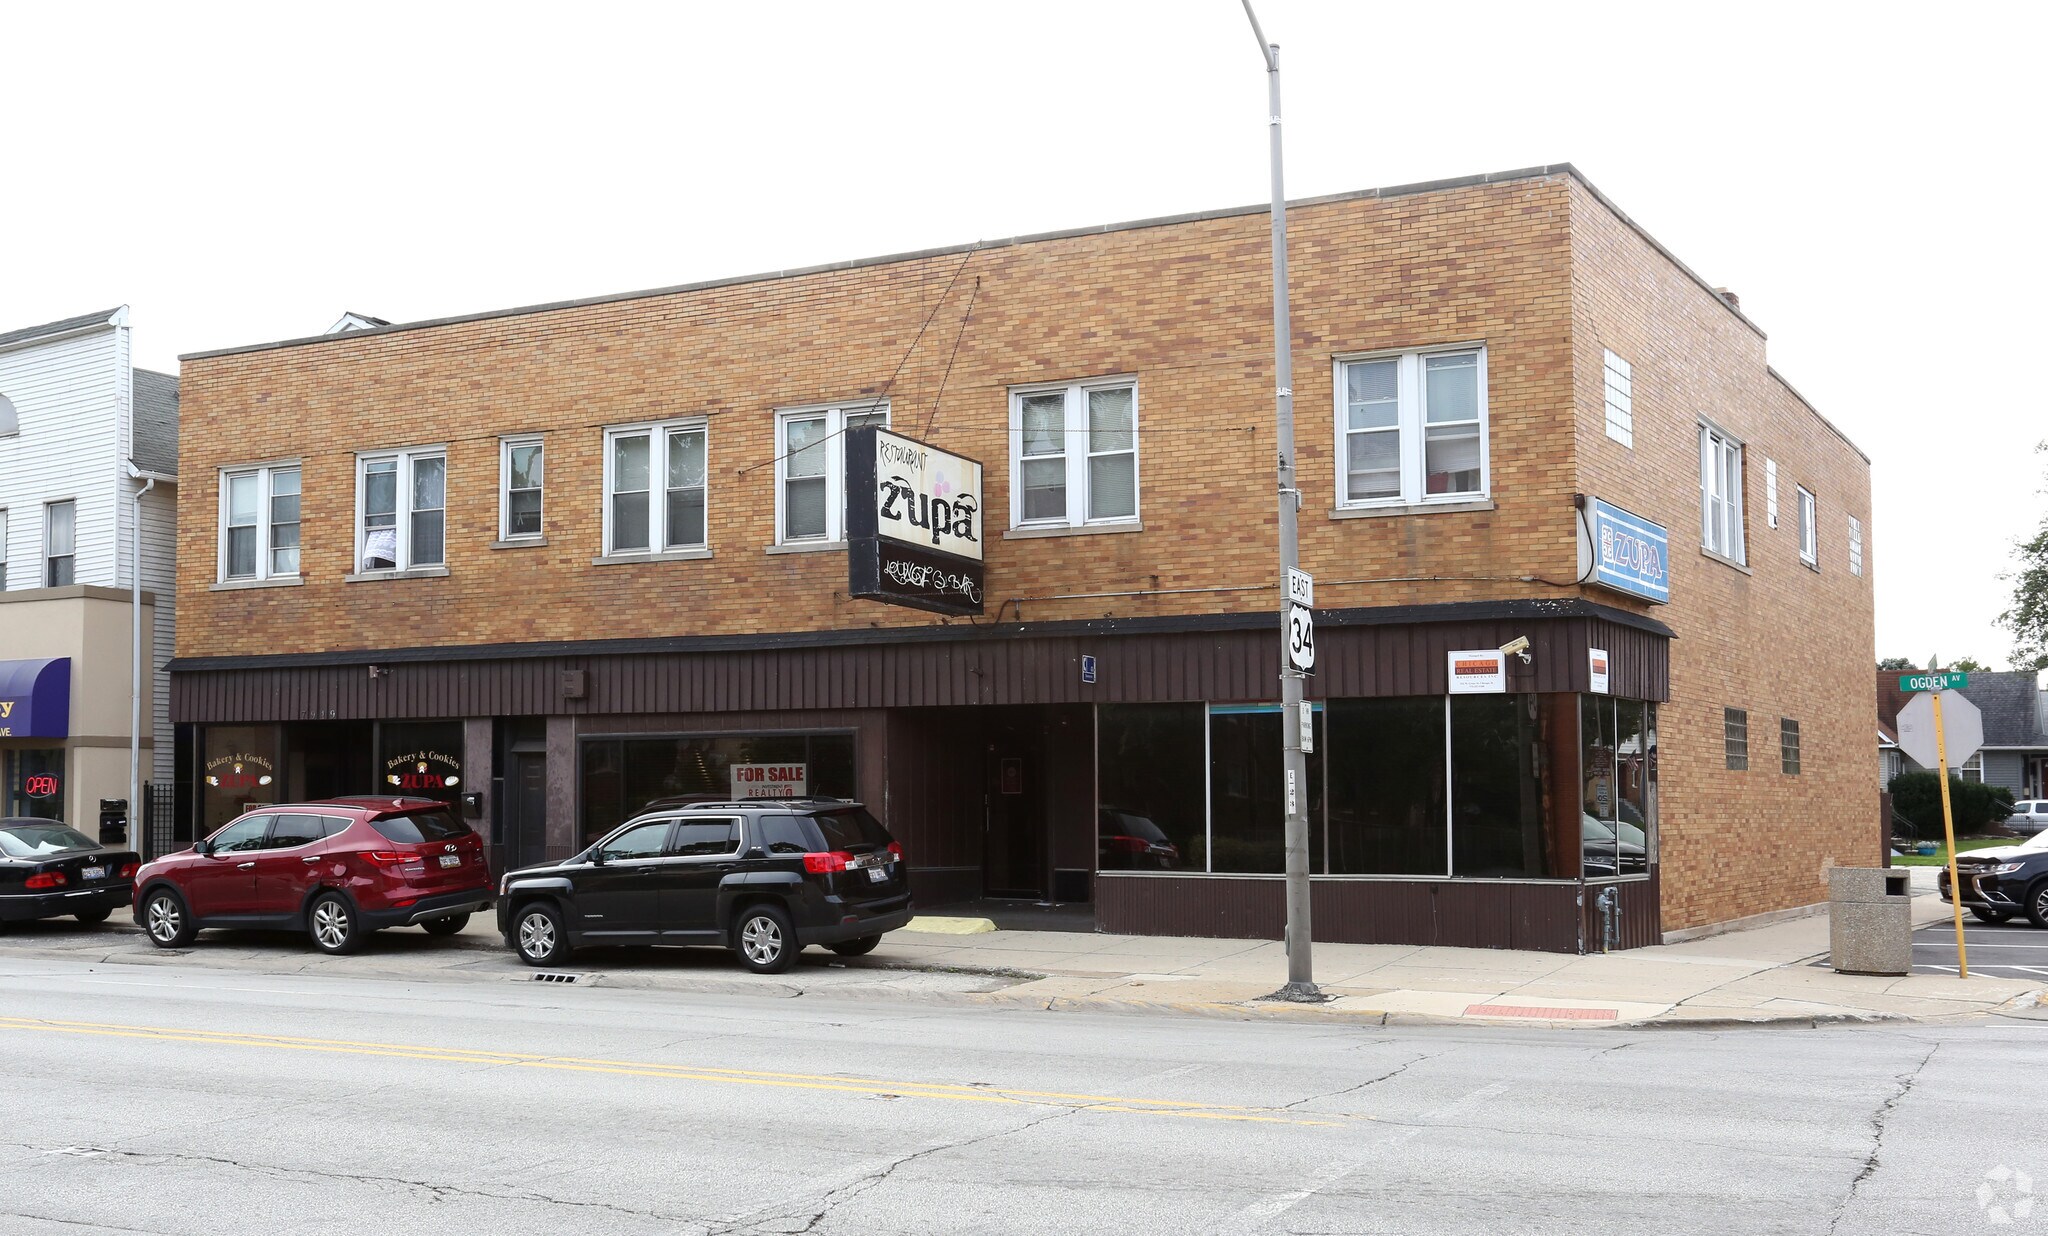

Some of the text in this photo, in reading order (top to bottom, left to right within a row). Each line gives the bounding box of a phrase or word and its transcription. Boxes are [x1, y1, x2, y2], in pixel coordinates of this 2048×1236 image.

[880, 440, 927, 474] RESTAURANT
[1614, 531, 1662, 579] ZUPA
[1292, 576, 1309, 598] EAST
[1292, 617, 1312, 657] 34
[1910, 676, 1948, 689] OGDEN
[0, 701, 15, 718] y
[207, 753, 273, 771] Bakery & Cookies
[387, 751, 460, 769] Bakery & Cookies
[400, 773, 445, 788] ZUPA
[737, 767, 803, 781] FOR SALE
[26, 777, 57, 794] OPEN
